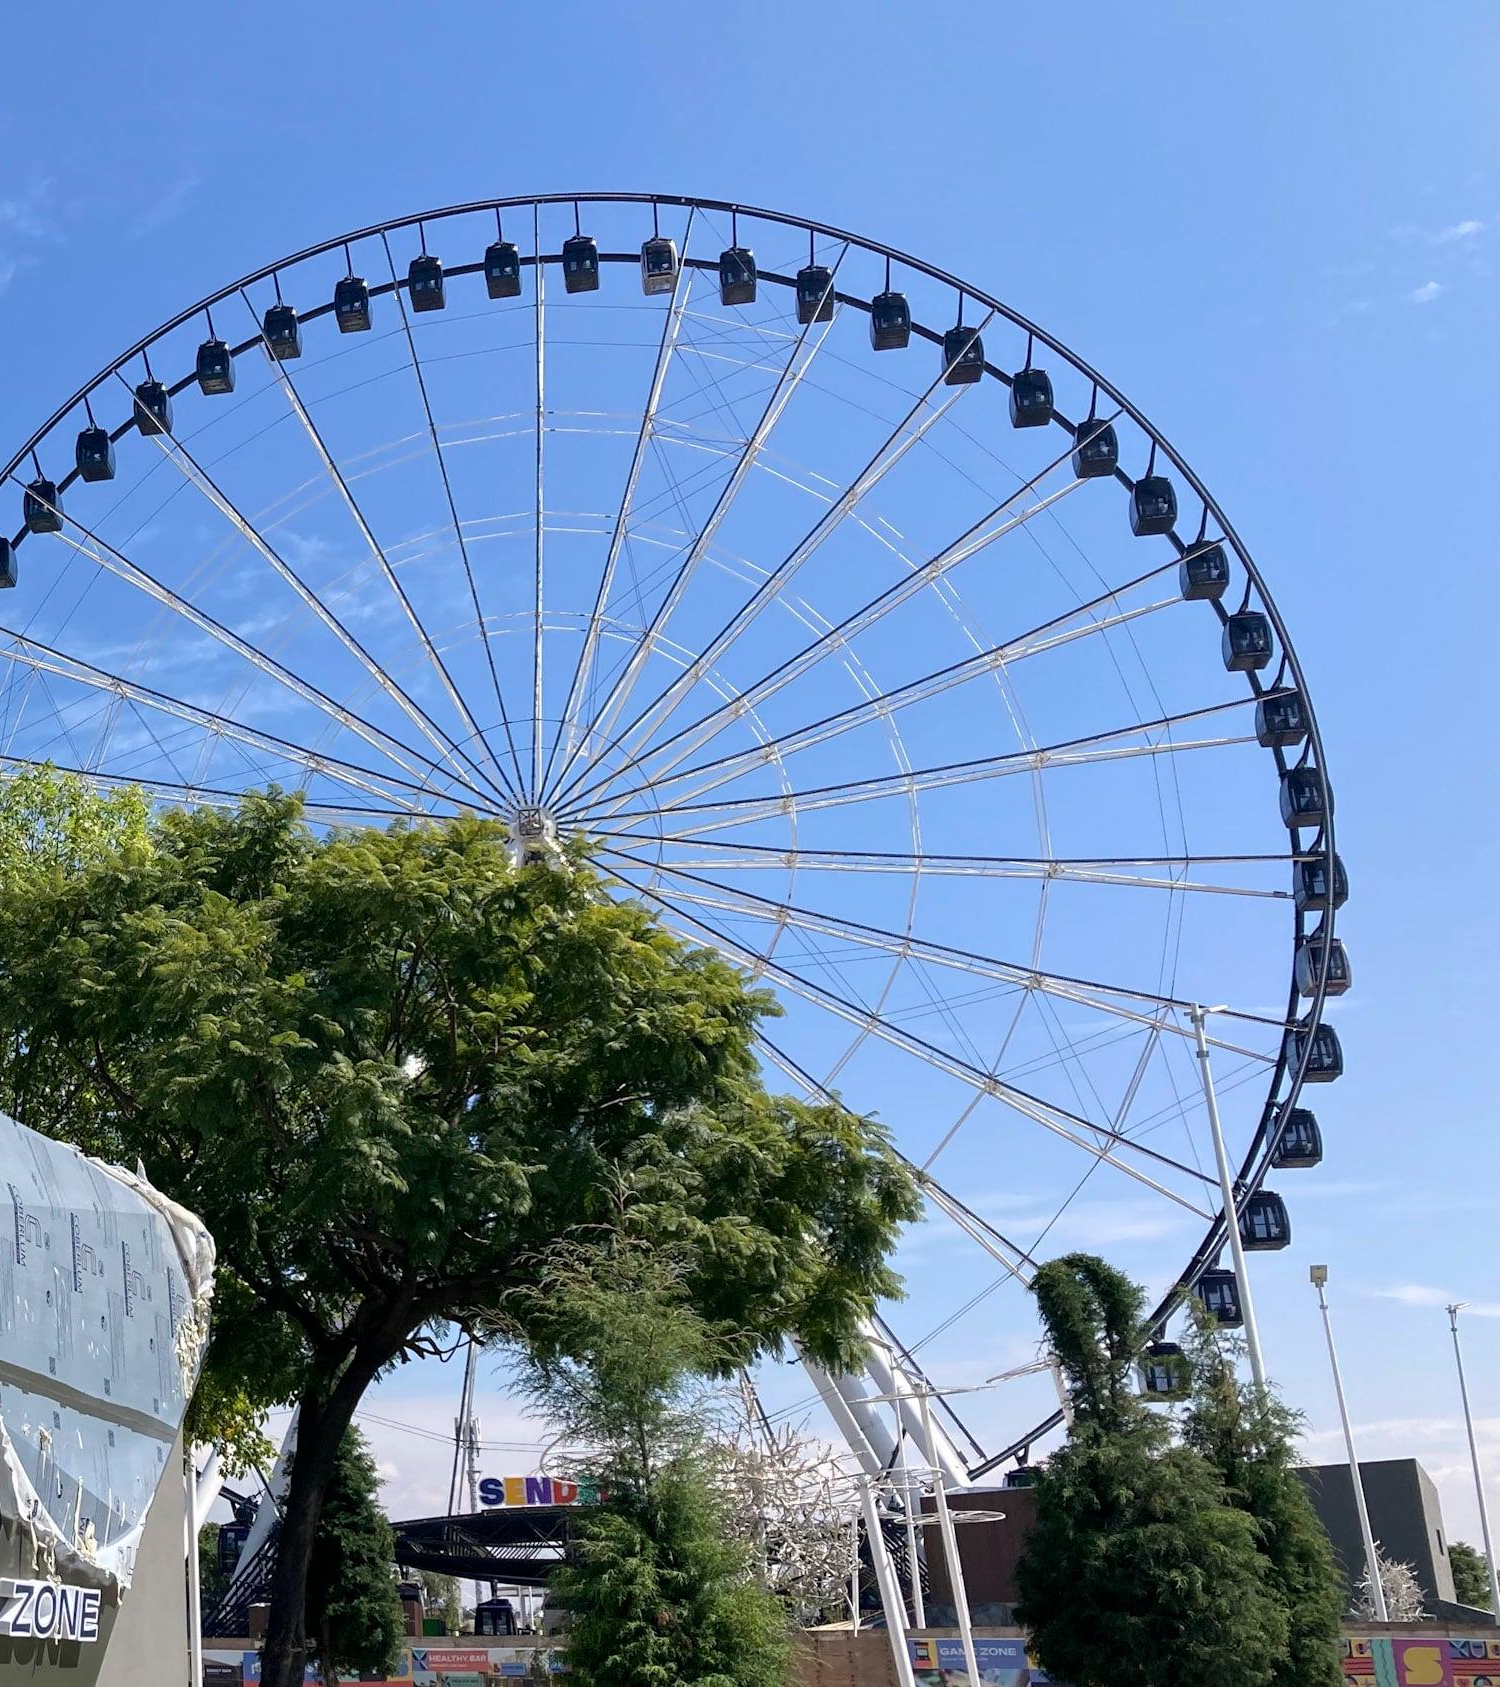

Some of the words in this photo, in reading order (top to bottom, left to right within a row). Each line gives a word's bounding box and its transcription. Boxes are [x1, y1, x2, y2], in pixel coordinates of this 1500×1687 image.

[9, 1582, 101, 1641] ZONE
[939, 1647, 978, 1657] GAM
[980, 1647, 1017, 1657] ZONE
[428, 1654, 467, 1663] HEALTHY
[469, 1654, 487, 1663] BAR
